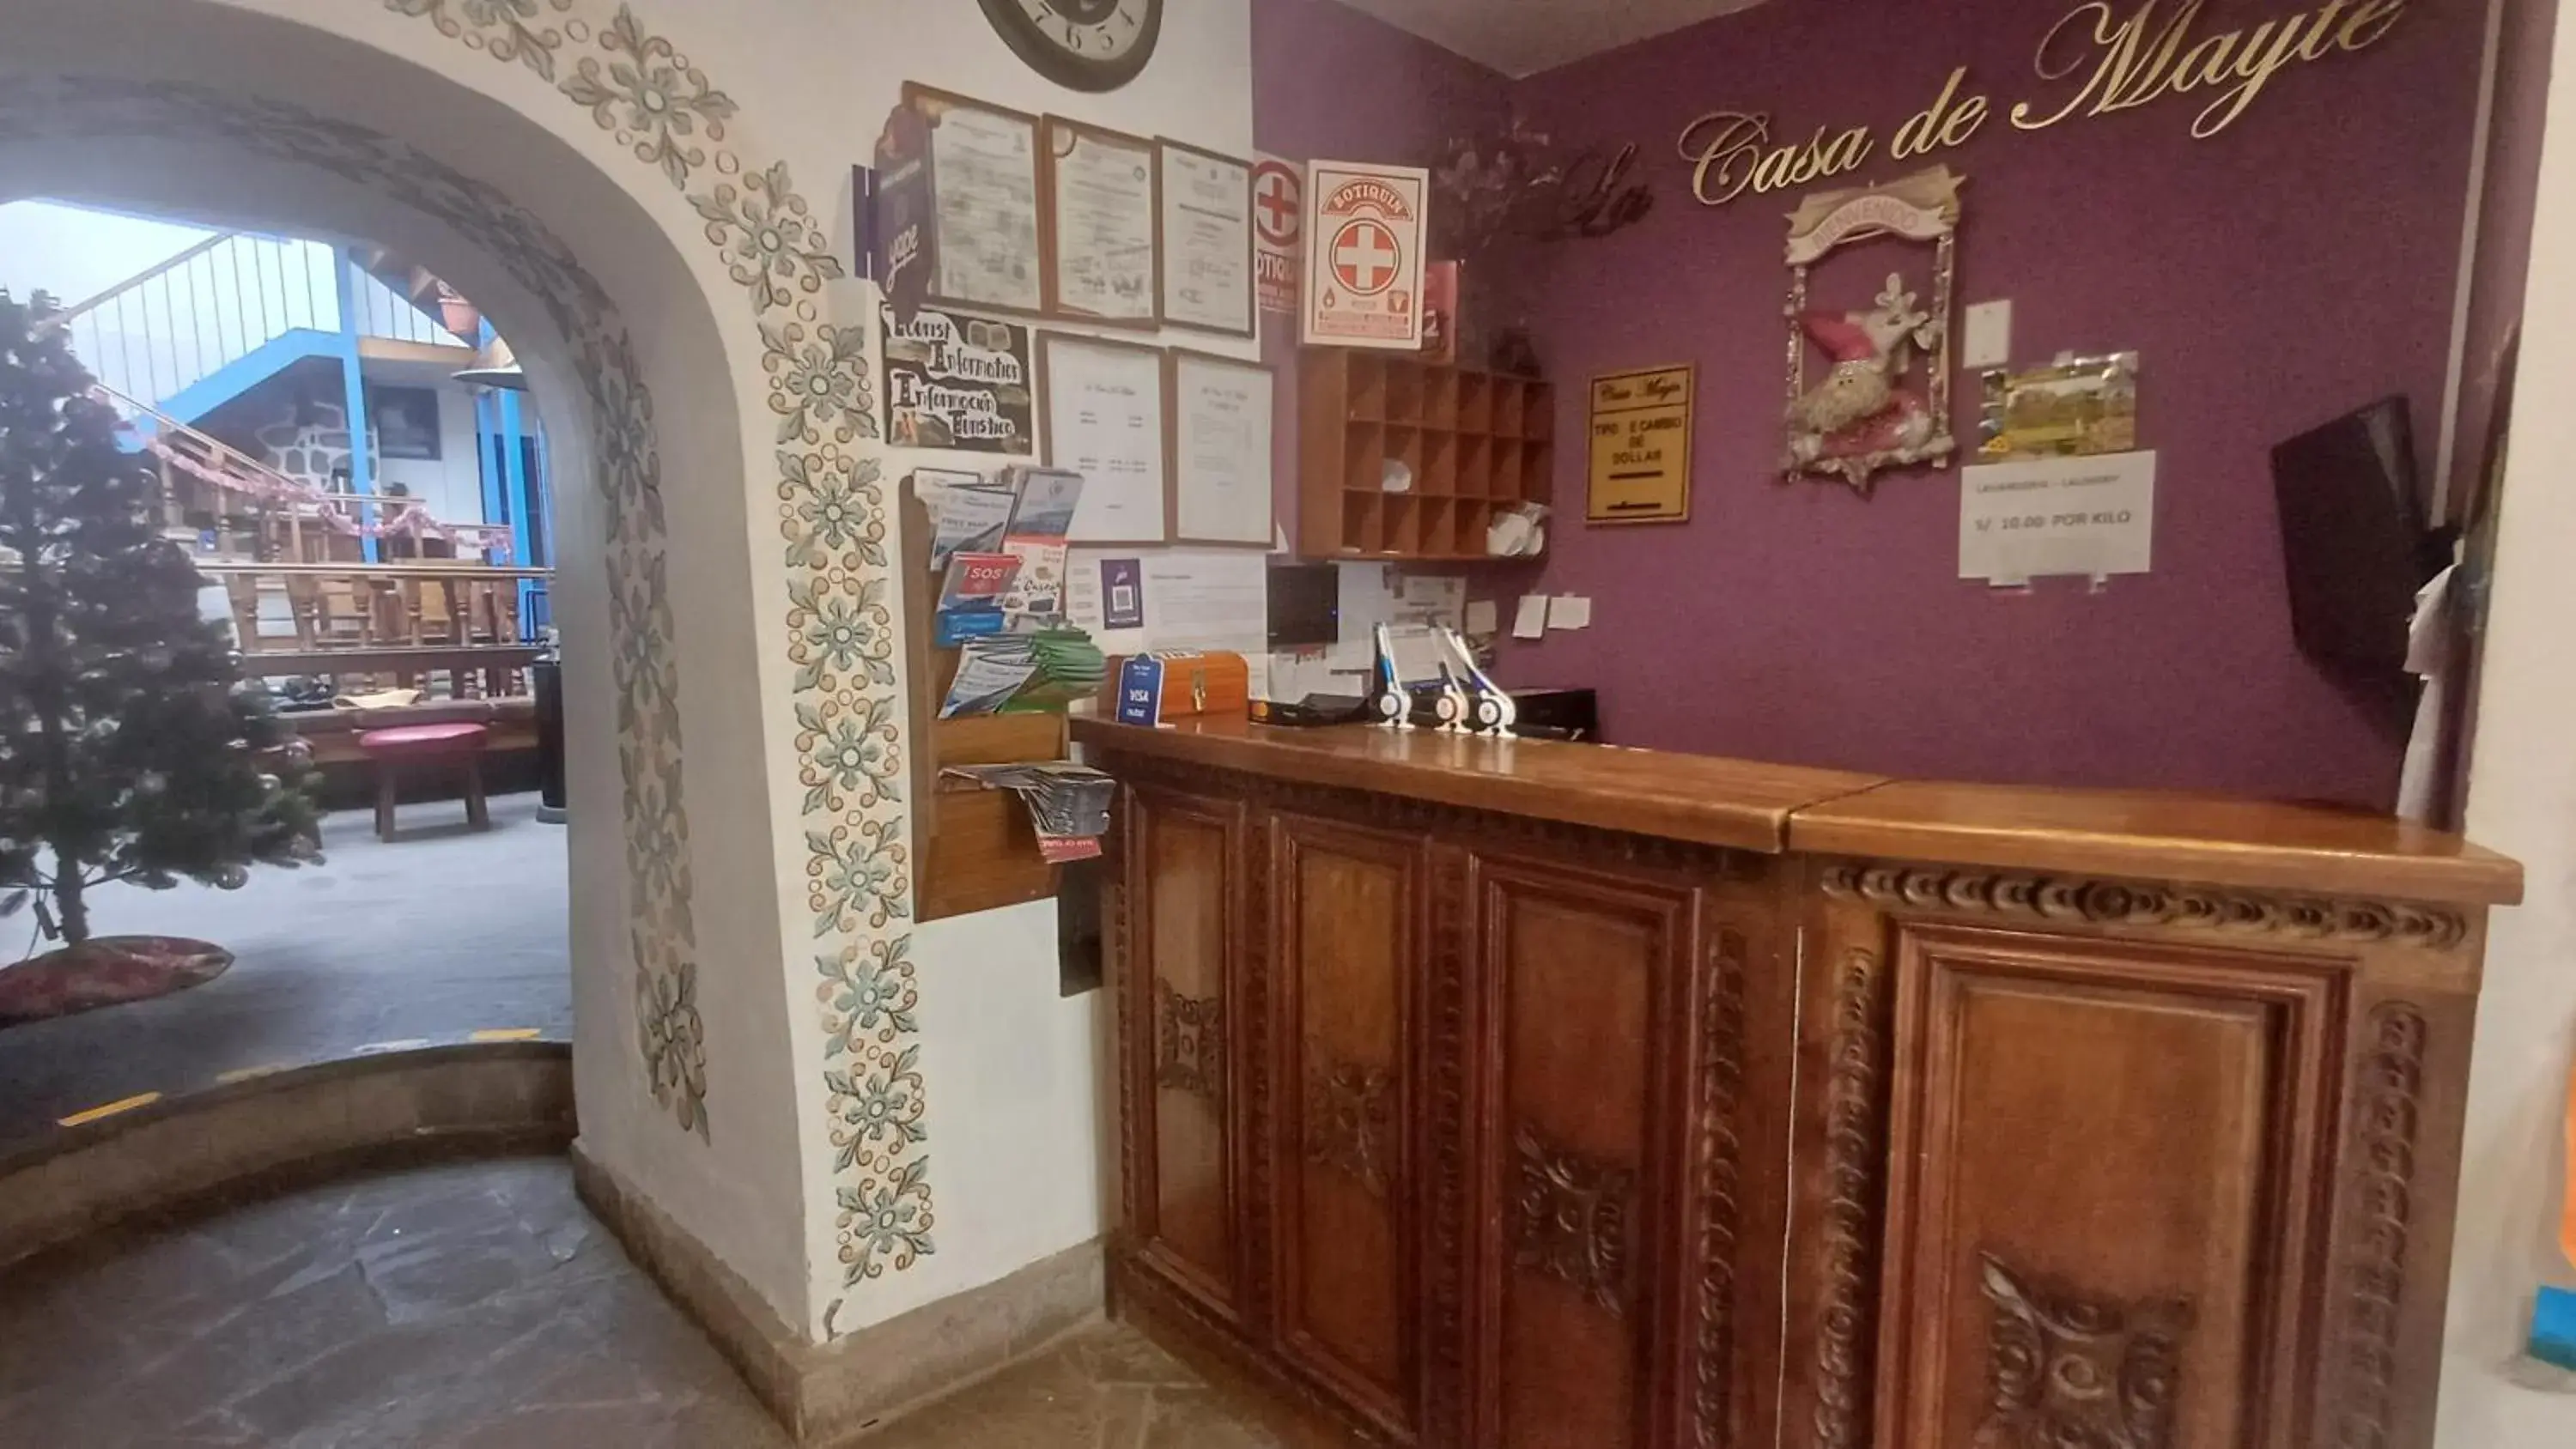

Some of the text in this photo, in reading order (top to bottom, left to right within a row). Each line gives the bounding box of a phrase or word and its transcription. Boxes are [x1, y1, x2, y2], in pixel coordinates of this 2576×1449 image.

[1678, 111, 1874, 205] Casa
[1891, 66, 1988, 160] de
[2009, 0, 2406, 139] Mayte
[1333, 184, 1405, 214] BOTIQUIN
[2051, 512, 2088, 528] POR
[2091, 510, 2132, 525] KILO
